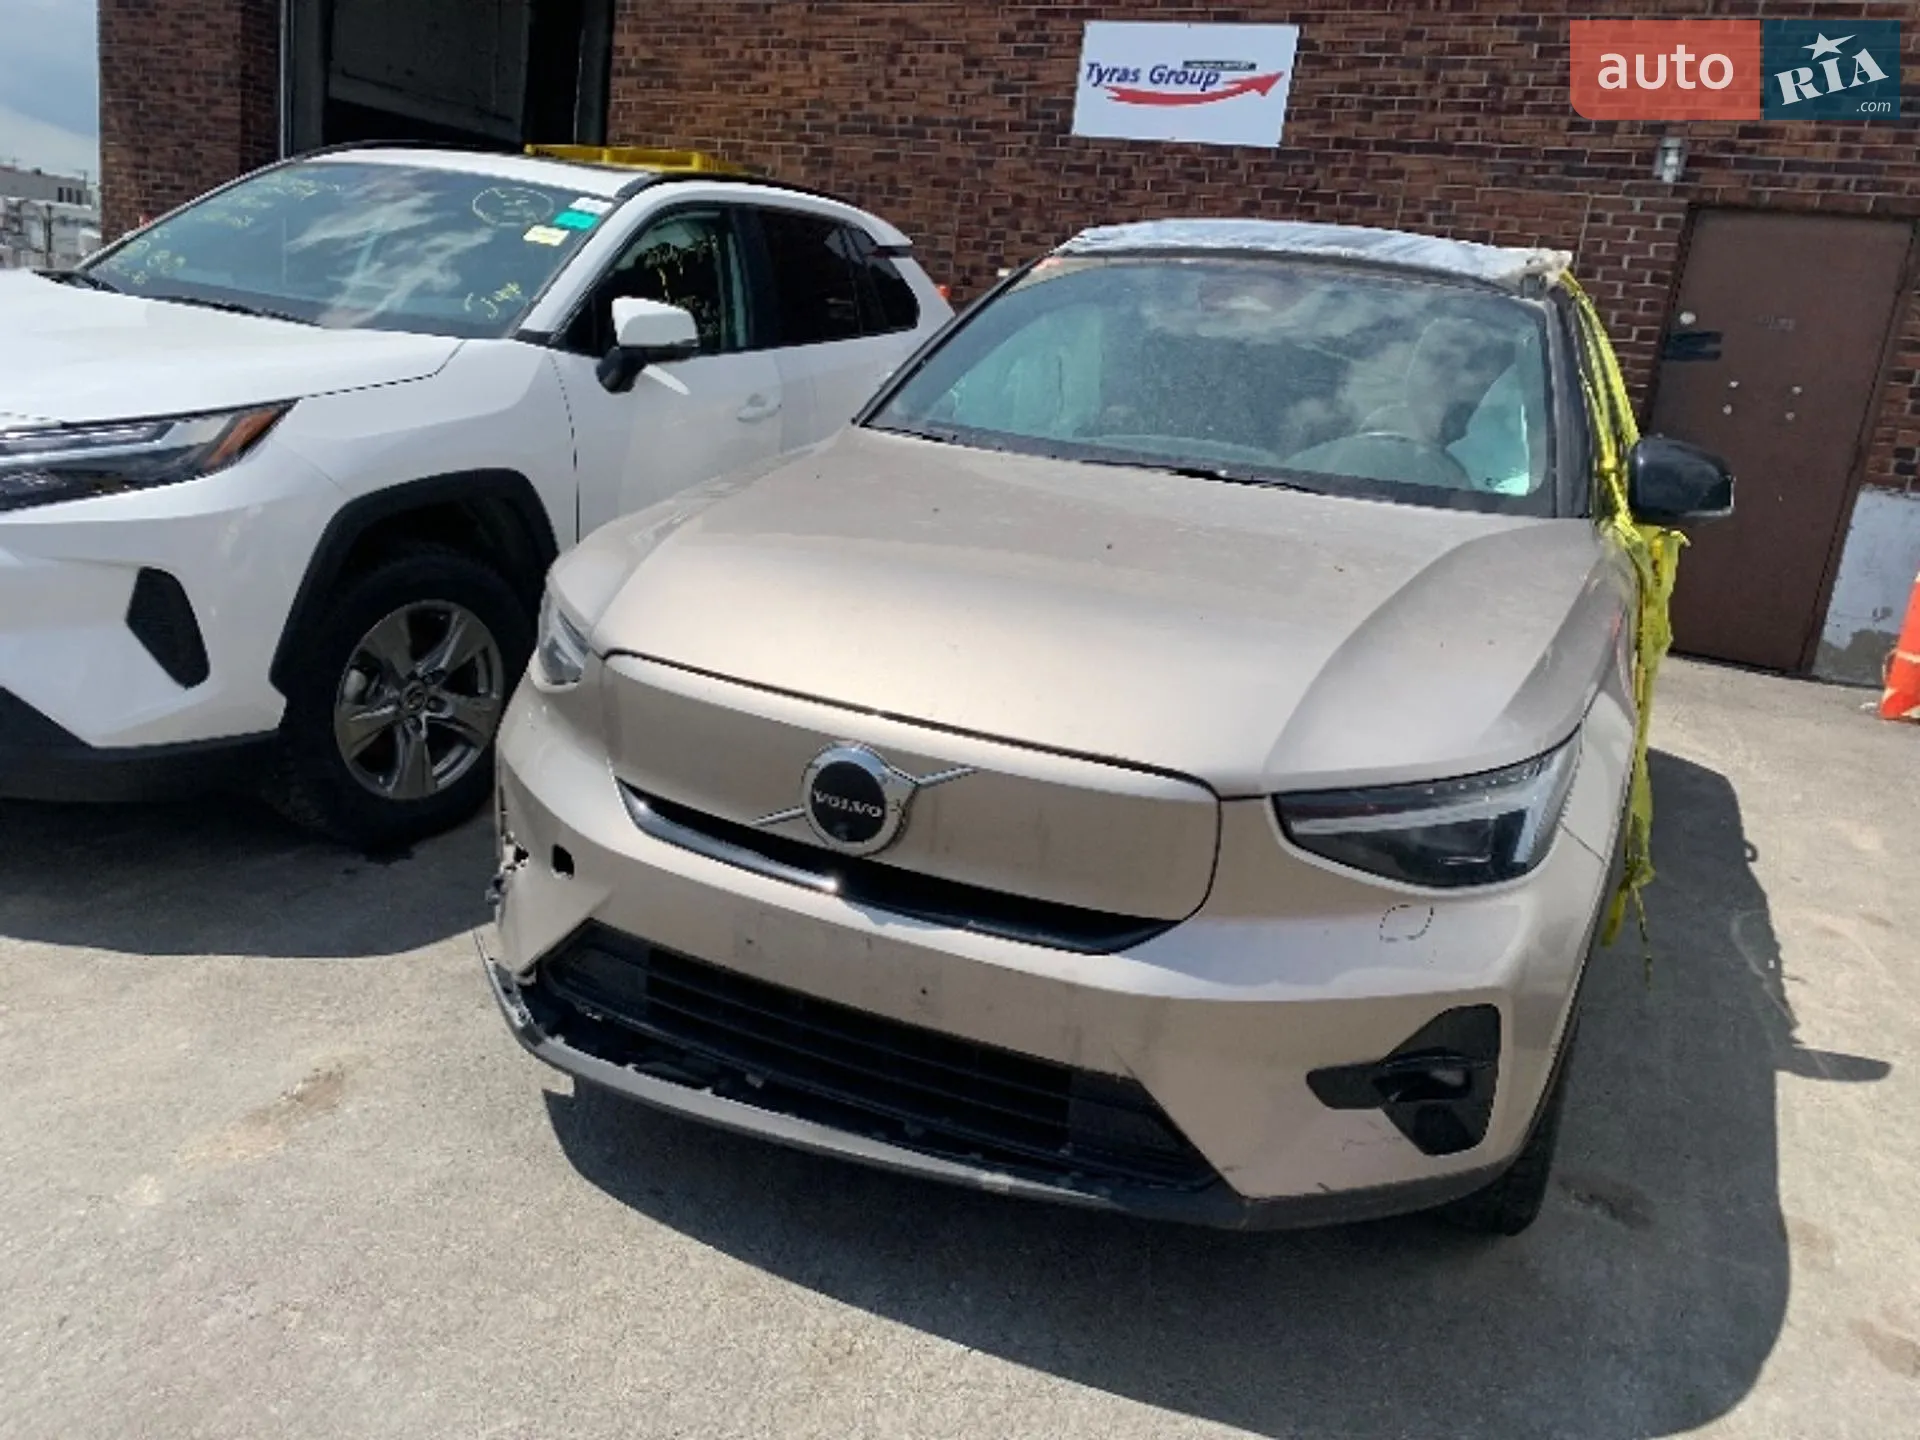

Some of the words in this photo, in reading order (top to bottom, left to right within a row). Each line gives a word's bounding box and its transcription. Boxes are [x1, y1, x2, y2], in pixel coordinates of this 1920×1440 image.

[1086, 63, 1141, 87] Tyras
[1149, 65, 1220, 91] Group
[813, 790, 883, 817] VOLVO
